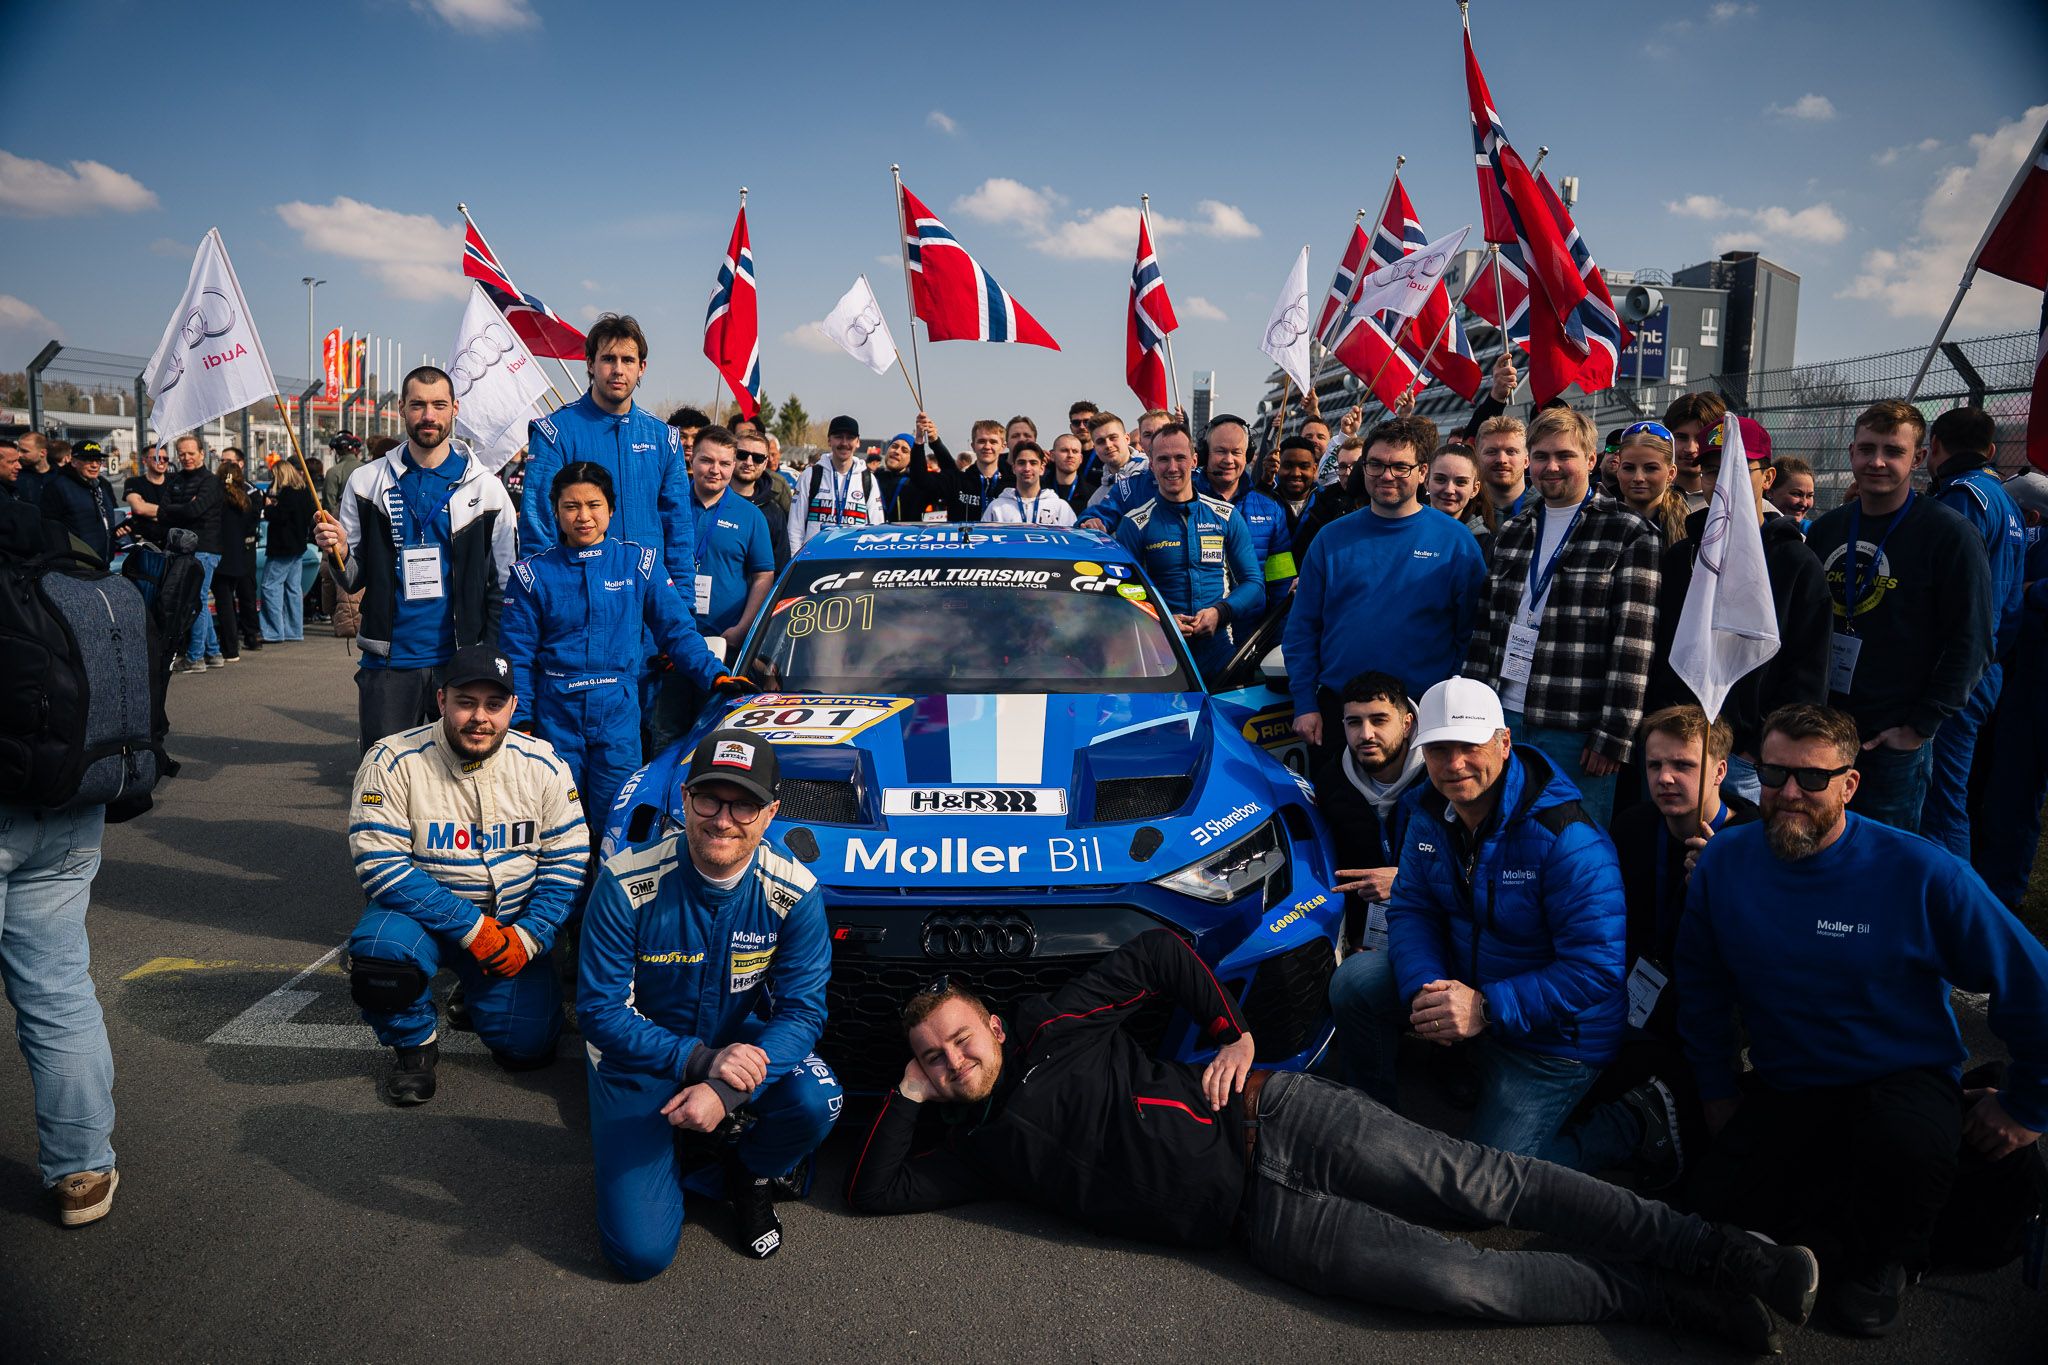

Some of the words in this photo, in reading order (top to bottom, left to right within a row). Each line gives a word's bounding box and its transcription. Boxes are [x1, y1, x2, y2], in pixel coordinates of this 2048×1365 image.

[110, 459, 117, 471] 6
[821, 499, 857, 511] MANI
[820, 513, 856, 524] RACNG
[857, 532, 1007, 544] Moller
[1025, 533, 1070, 545] Bil
[854, 543, 975, 551] Motorsport
[872, 568, 940, 583] GRAN
[604, 579, 625, 588] Moller
[786, 594, 875, 638] 801
[568, 681, 589, 689] Anders
[734, 708, 856, 728] 801
[463, 760, 481, 773] OMP
[1205, 802, 1261, 836] Sharebox
[426, 822, 506, 853] Mobil
[844, 838, 1028, 874] Moller
[1049, 836, 1102, 873] Bil
[630, 880, 655, 896] OMP
[772, 890, 796, 907] OMP
[1269, 895, 1327, 933] GOODYEAR
[1817, 920, 1854, 932] Moller
[1857, 923, 1870, 934] Bil
[732, 931, 766, 944] Moller
[1816, 930, 1845, 938] Motorsport
[731, 942, 759, 950] Motorsport
[755, 1232, 780, 1253] OMP
